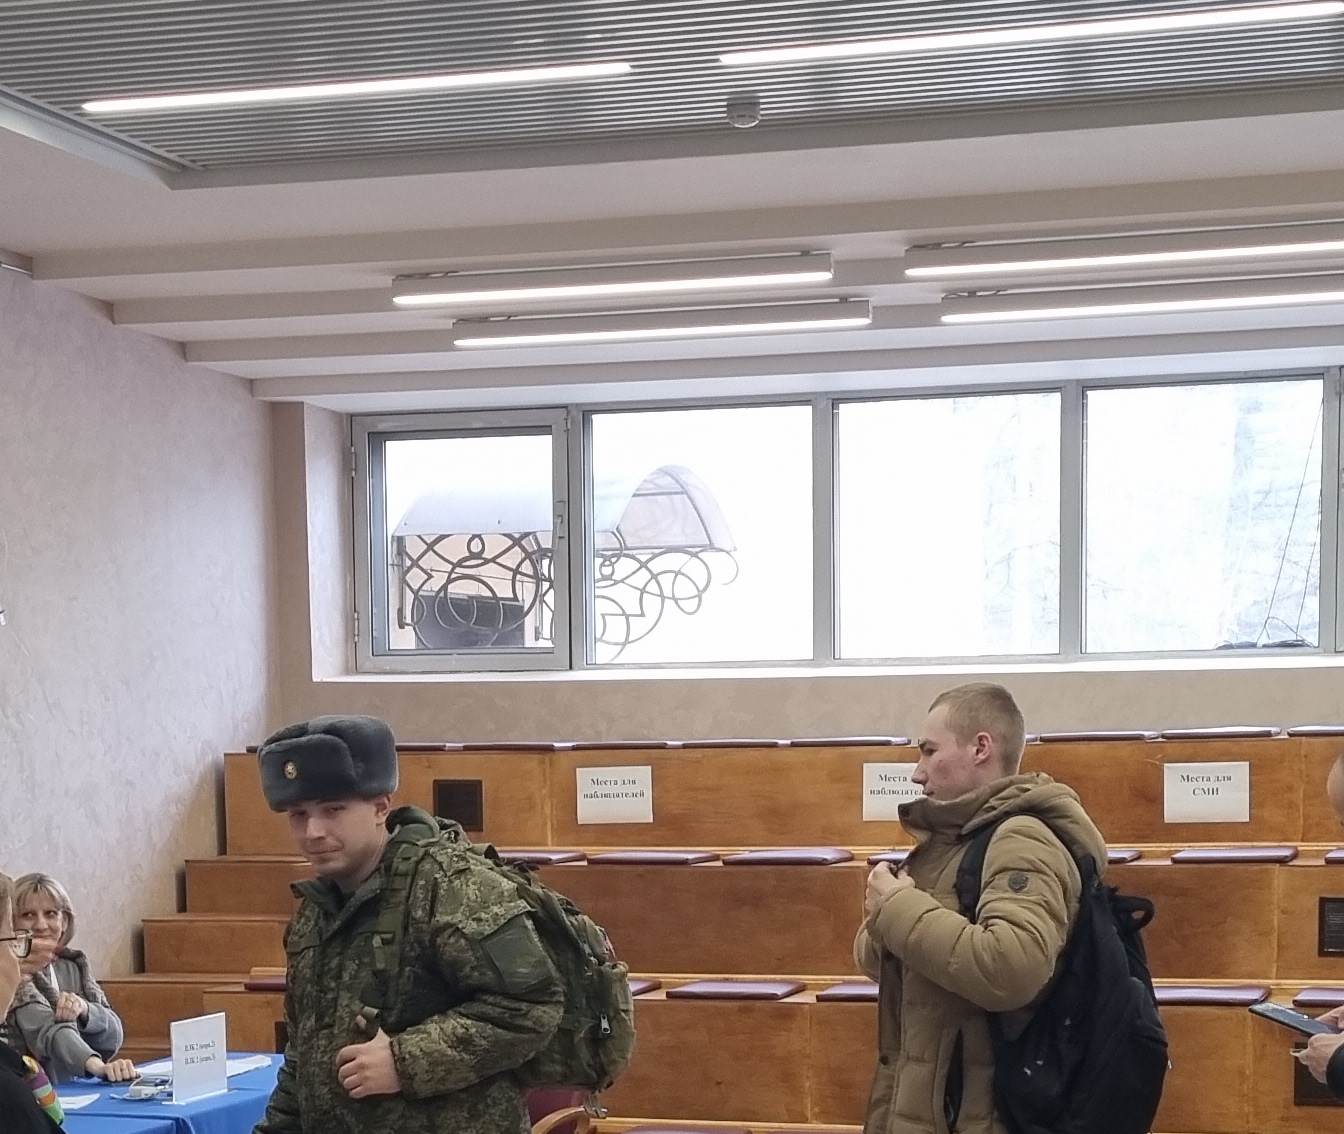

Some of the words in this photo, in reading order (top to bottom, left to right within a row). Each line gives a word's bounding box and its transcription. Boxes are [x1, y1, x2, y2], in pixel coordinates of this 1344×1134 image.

[590, 778, 619, 786] Места
[620, 778, 637, 786] для
[878, 773, 908, 782] Места
[1180, 774, 1211, 783] Места
[1213, 775, 1232, 783] для
[583, 789, 645, 799] наблюдателей
[869, 787, 925, 796] наблюдател
[1192, 787, 1219, 796] СМИ
